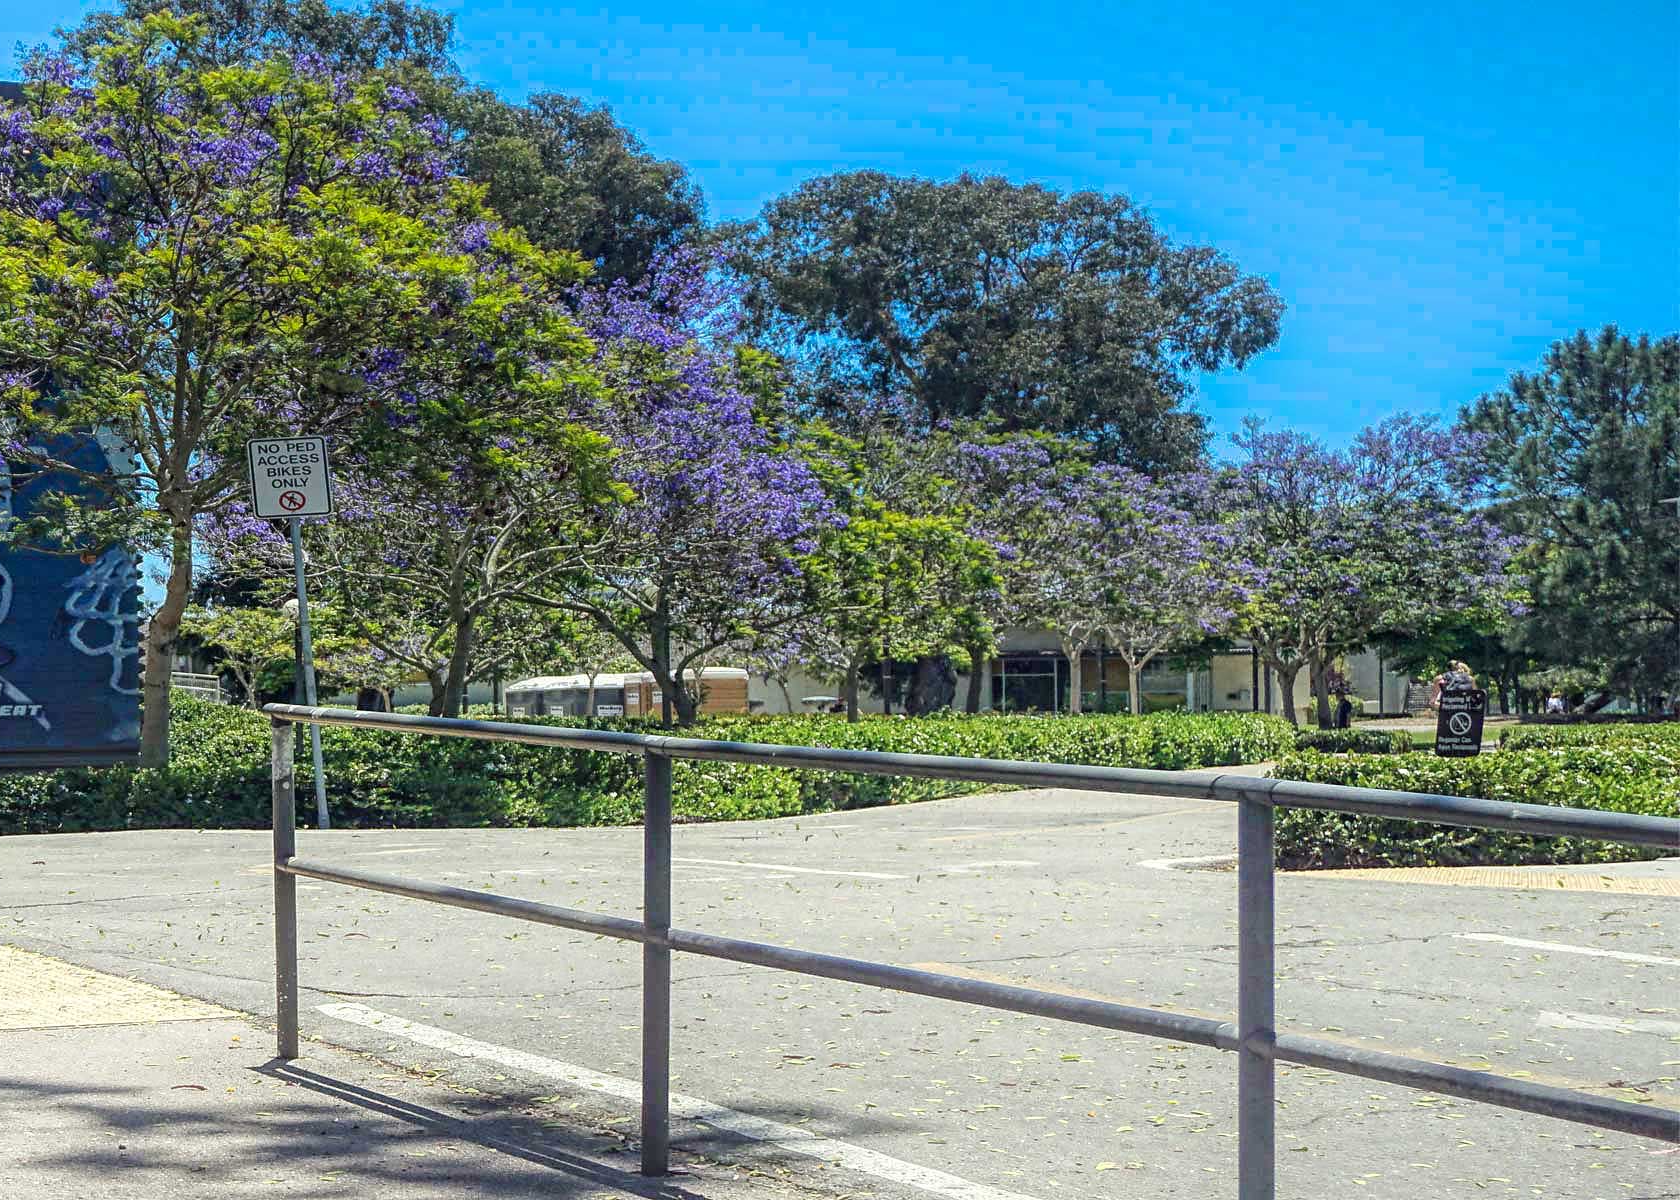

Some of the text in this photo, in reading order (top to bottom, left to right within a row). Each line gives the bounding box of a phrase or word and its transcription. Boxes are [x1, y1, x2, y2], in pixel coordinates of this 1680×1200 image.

[257, 442, 316, 454] NO PED
[257, 453, 319, 466] ACCESS
[267, 466, 312, 477] BIKES
[271, 477, 309, 488] ONLY
